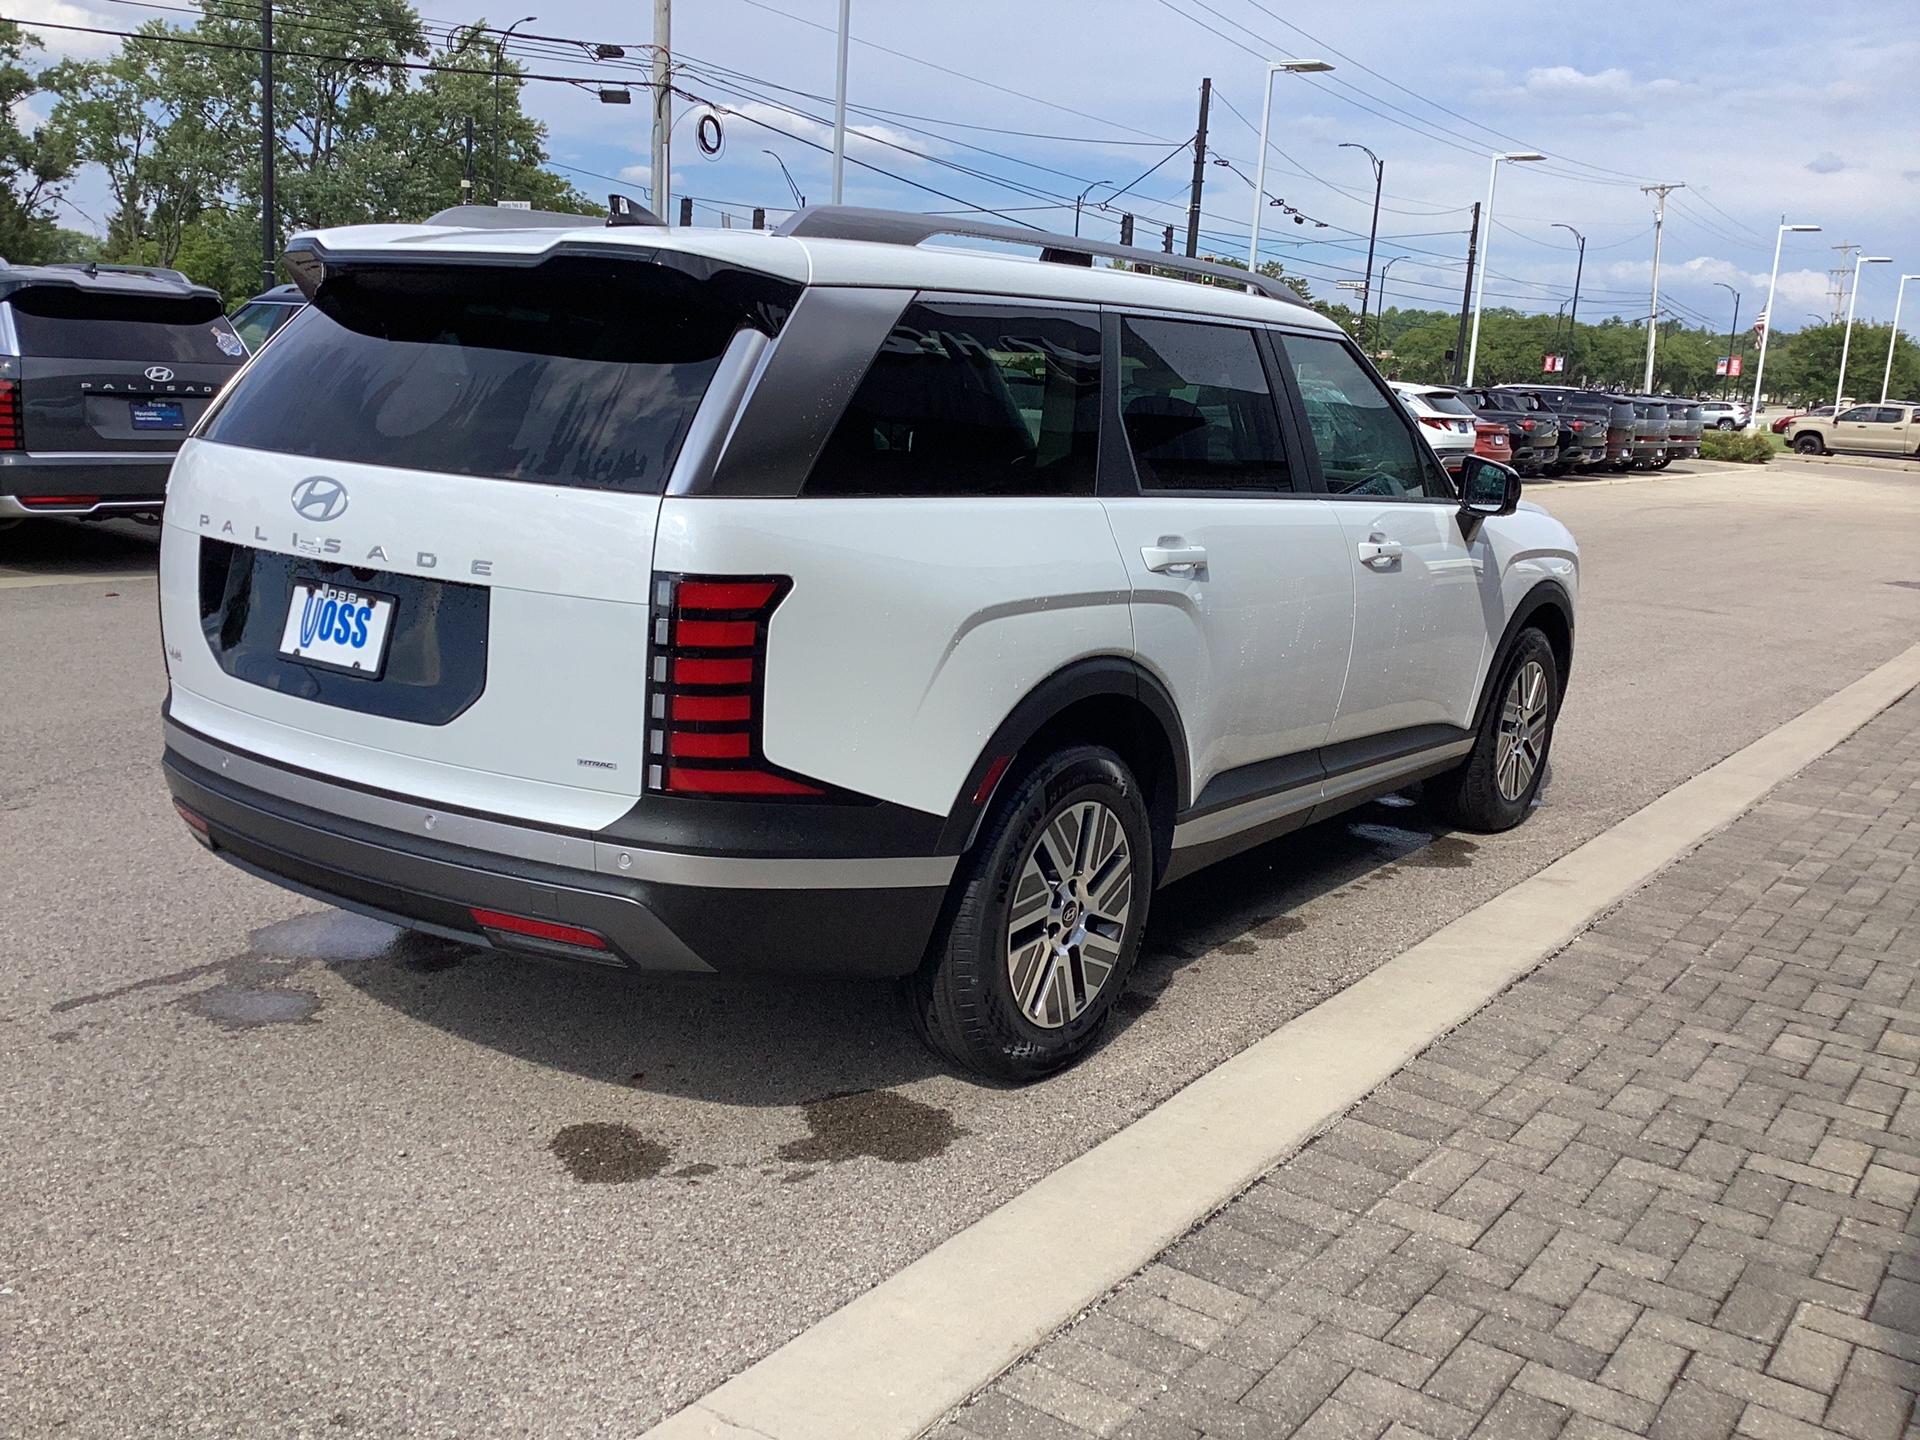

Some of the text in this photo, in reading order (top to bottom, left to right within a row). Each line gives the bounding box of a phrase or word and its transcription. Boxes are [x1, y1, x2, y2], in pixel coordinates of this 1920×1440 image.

[80, 382, 213, 393] PALISAD
[199, 514, 493, 576] PALISADE
[300, 595, 372, 649] VOSS
